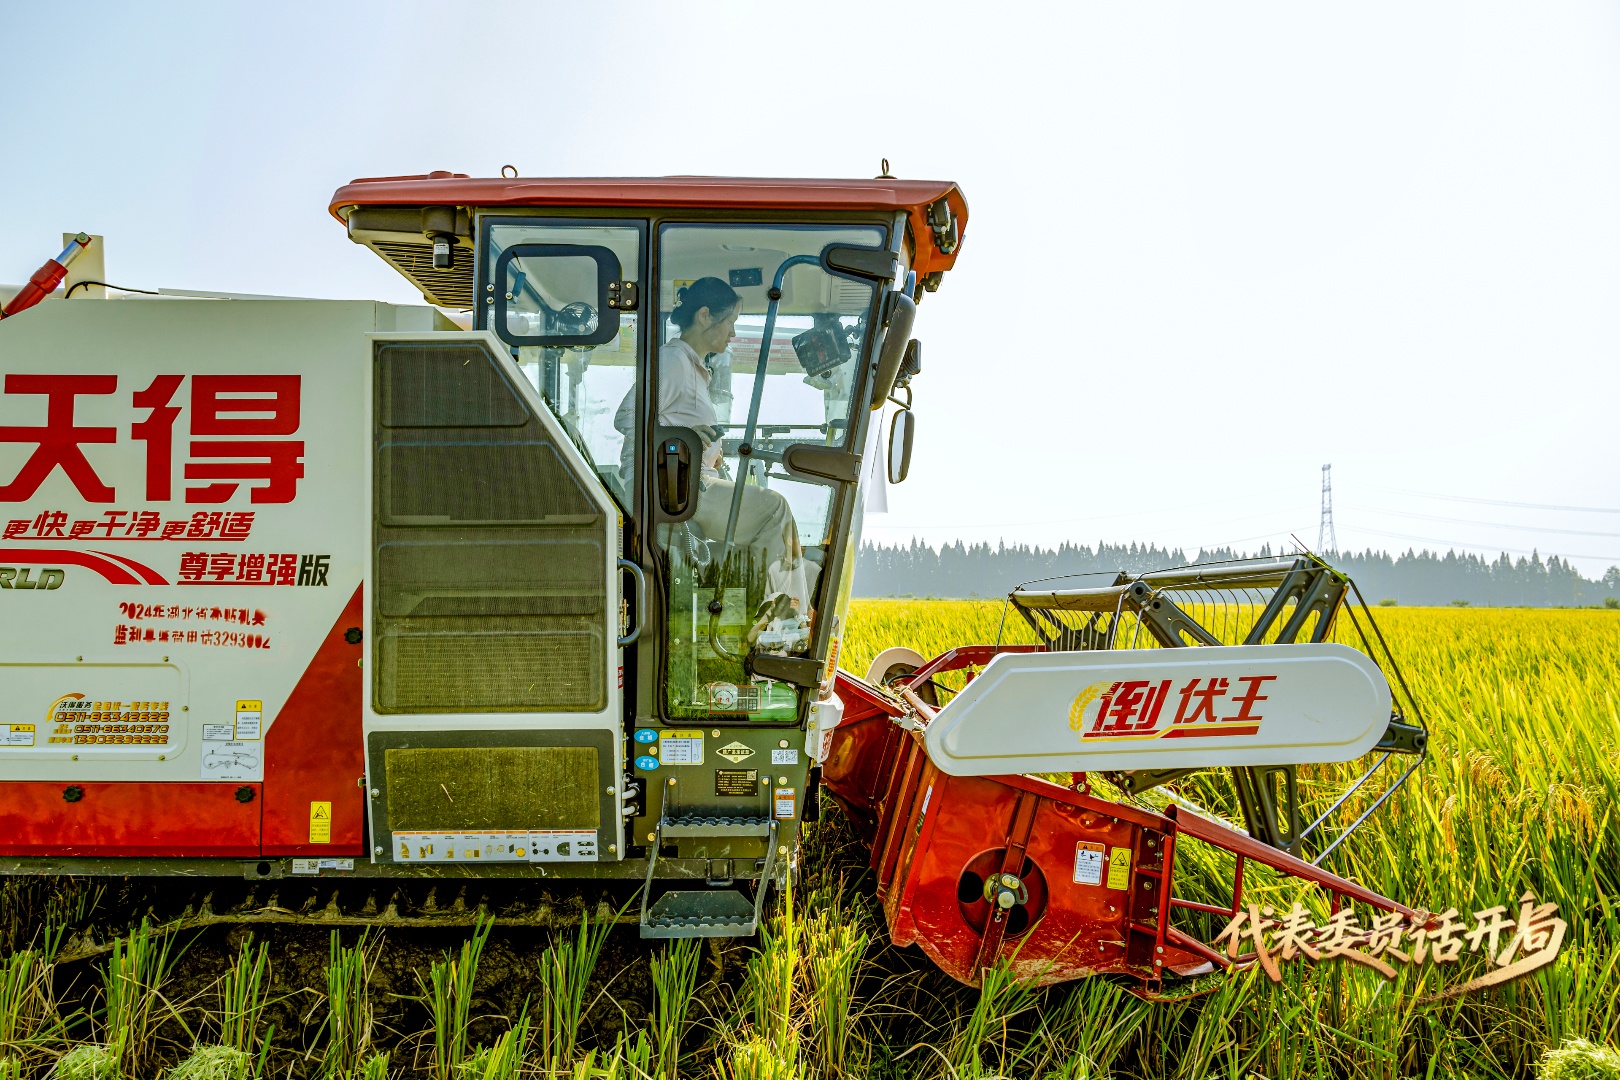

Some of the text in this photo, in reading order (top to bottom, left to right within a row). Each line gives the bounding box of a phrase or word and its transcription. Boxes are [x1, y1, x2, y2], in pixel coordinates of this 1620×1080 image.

[2, 510, 255, 540] 更快更干净更舒适
[178, 552, 331, 587] 尊享增强版
[1092, 675, 1278, 731] 倒伏王
[54, 711, 169, 722] 0511-86342622
[74, 724, 169, 734] 0511-86340670
[73, 735, 169, 745] 13905292222
